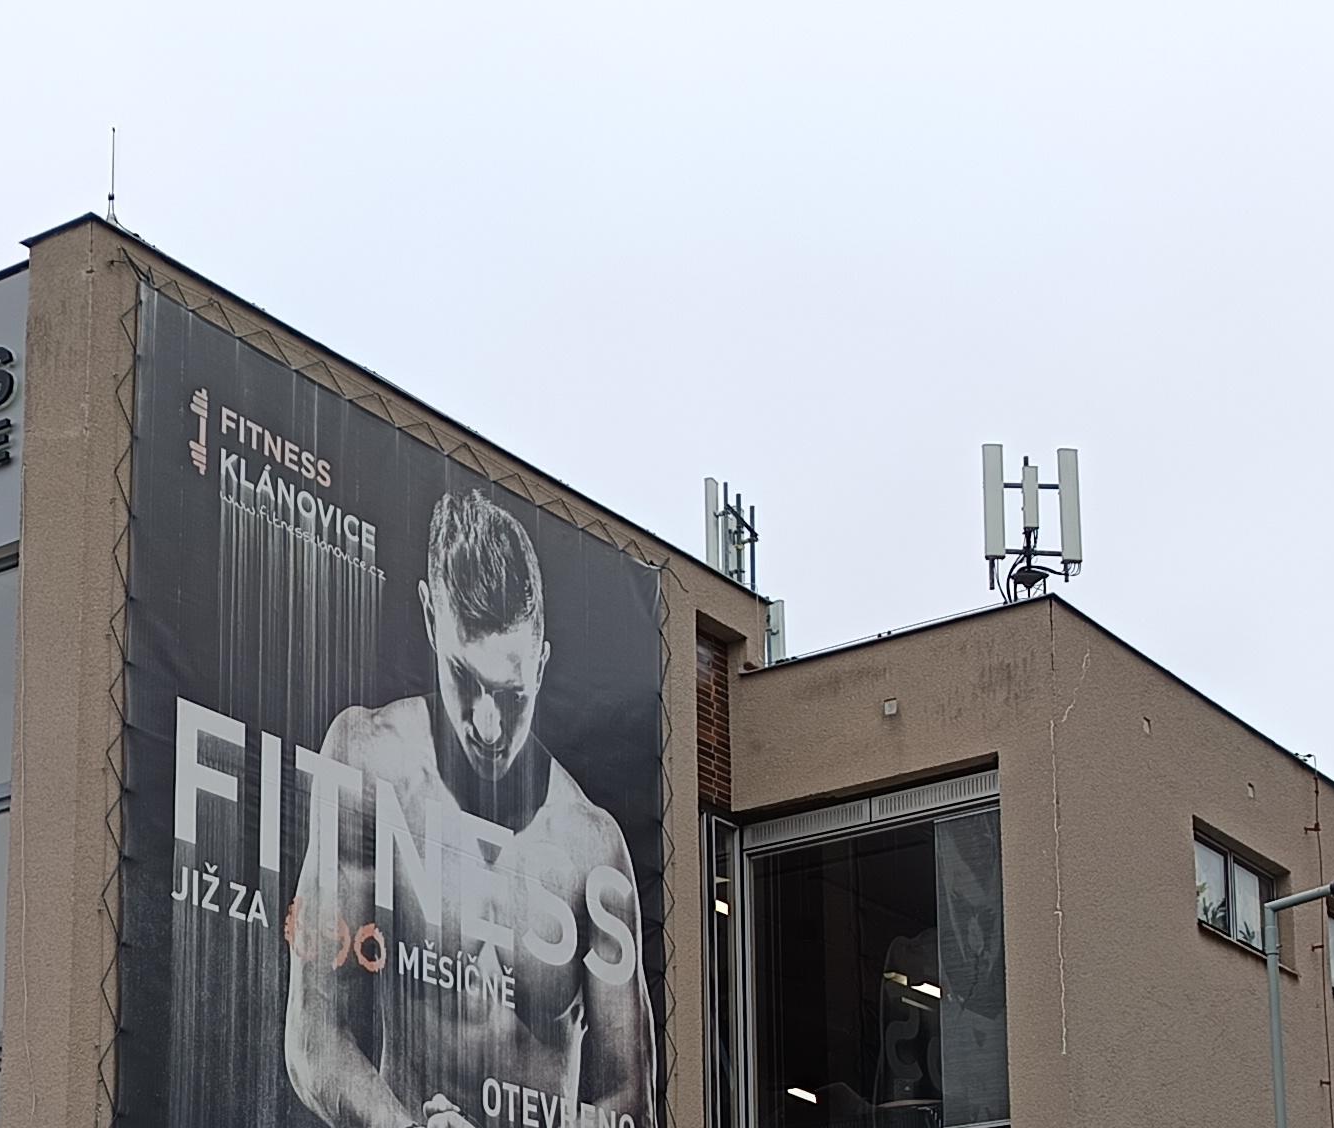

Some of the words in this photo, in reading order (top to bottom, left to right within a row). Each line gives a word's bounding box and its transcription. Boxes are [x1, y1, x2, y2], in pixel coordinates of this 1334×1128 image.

[221, 406, 331, 487] FITNESS
[220, 447, 376, 550] KLÁNOVICE
[174, 696, 636, 986] FITNESS
[171, 861, 220, 913] JIŽ
[229, 881, 269, 928] ZA
[398, 939, 516, 1009] MĚSÍČNĚ
